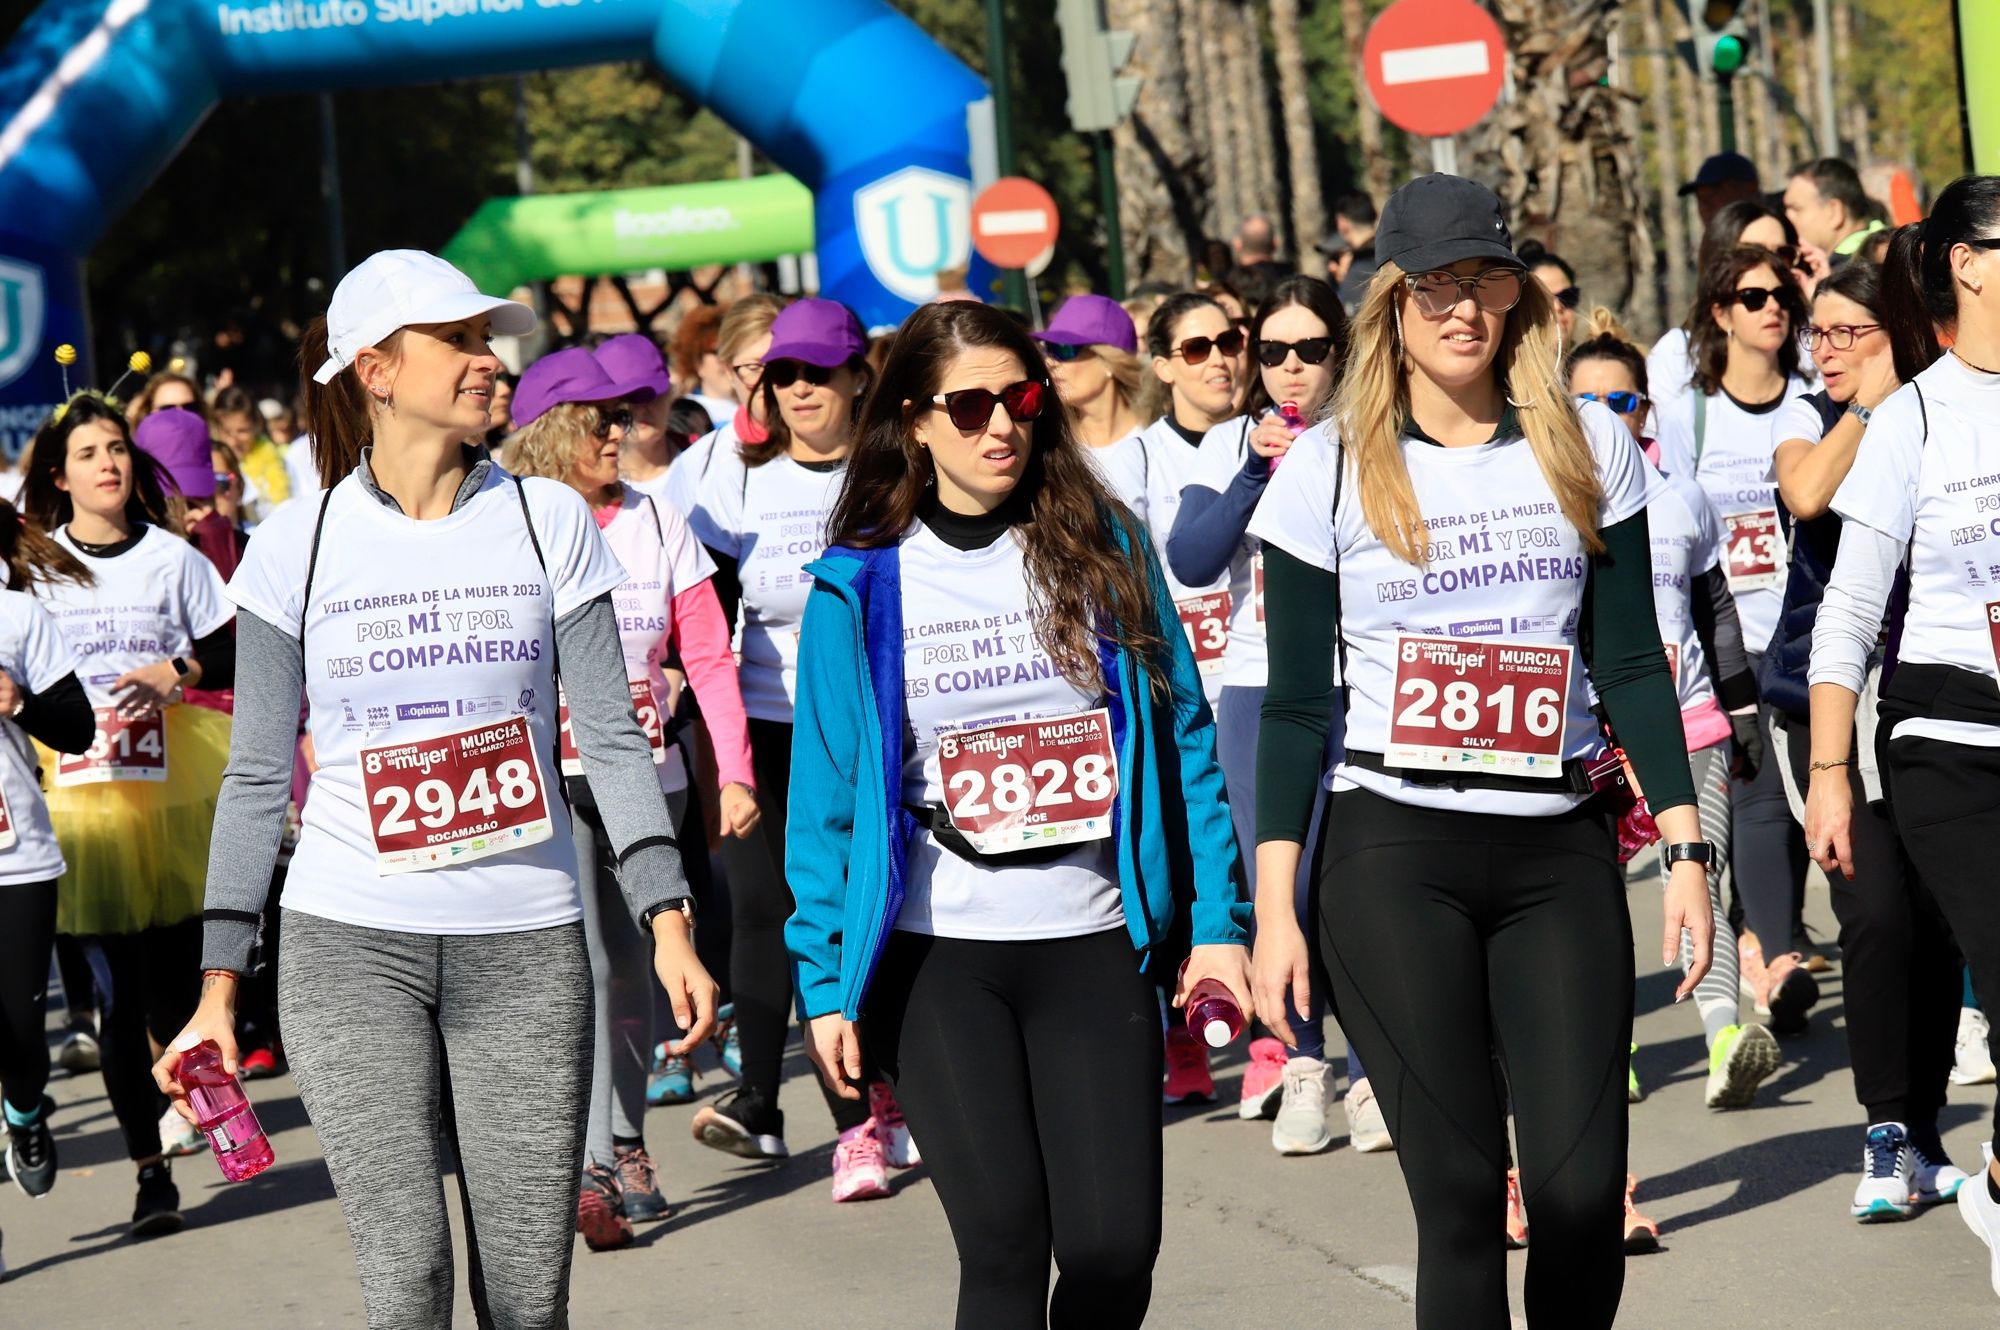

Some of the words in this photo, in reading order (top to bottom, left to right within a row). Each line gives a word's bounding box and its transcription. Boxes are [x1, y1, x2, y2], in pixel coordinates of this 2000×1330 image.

[218, 0, 368, 35] Instituto
[1944, 481, 1967, 493] VIII
[1970, 473, 2000, 488] CARR
[1737, 489, 1774, 503] COM
[1975, 493, 2000, 513] PO
[1421, 515, 1467, 531] RRERA
[1470, 512, 1487, 525] DE
[1491, 509, 1509, 521] LA
[1512, 503, 1556, 518] MUJER
[1458, 525, 1493, 555] MÍ
[1496, 531, 1512, 551] Y
[1517, 526, 1560, 549] POR
[1951, 525, 1986, 546] MIS
[616, 582, 639, 591] UJER
[1377, 579, 1418, 603] MIS
[1422, 553, 1583, 595] COMPAÑERAS
[1654, 573, 1686, 588] ERAS
[323, 600, 349, 614] VIII
[354, 592, 418, 611] CARRERA
[422, 589, 440, 603] DE
[444, 588, 461, 601] LA
[465, 585, 509, 599] MUJER
[513, 584, 541, 597] 2023
[357, 619, 403, 643] POR
[408, 604, 441, 635] MÍ
[446, 612, 463, 632] Y
[467, 609, 513, 631] POR
[919, 619, 981, 637] CARRERA
[984, 616, 1001, 629] DE
[1005, 612, 1022, 625] LA
[74, 635, 168, 656] COMPAÑERA
[327, 656, 364, 679] MIS
[368, 634, 541, 673] COMPAÑERAS
[924, 643, 969, 665] POR
[972, 629, 1006, 659] MÍ
[1009, 634, 1025, 654] Y
[1422, 642, 1458, 653] carrera
[1432, 651, 1485, 676] mujer
[1499, 650, 1562, 667] MURCIA
[1517, 666, 1543, 674] MARZO
[1544, 668, 1562, 676] 2023
[906, 677, 930, 699] IS
[1396, 678, 1560, 738] 2816
[460, 723, 522, 750] MURCIA
[960, 731, 996, 743] carrera
[1038, 719, 1101, 739] MURCIA
[1046, 739, 1056, 747] DE
[1057, 736, 1083, 745] MARZO
[1084, 732, 1103, 742] 2023
[383, 746, 418, 759] carrera
[462, 751, 468, 759] 5
[469, 748, 479, 756] DE
[480, 741, 506, 754] MARZO
[506, 736, 524, 747] 2023
[972, 734, 1025, 760] mujer
[1462, 736, 1496, 748] SILVY
[394, 747, 448, 775] mujer
[948, 754, 1112, 818] 2828
[372, 758, 537, 838] 2948
[1023, 812, 1047, 825] NOE
[426, 820, 499, 844] ROCAMASAO
